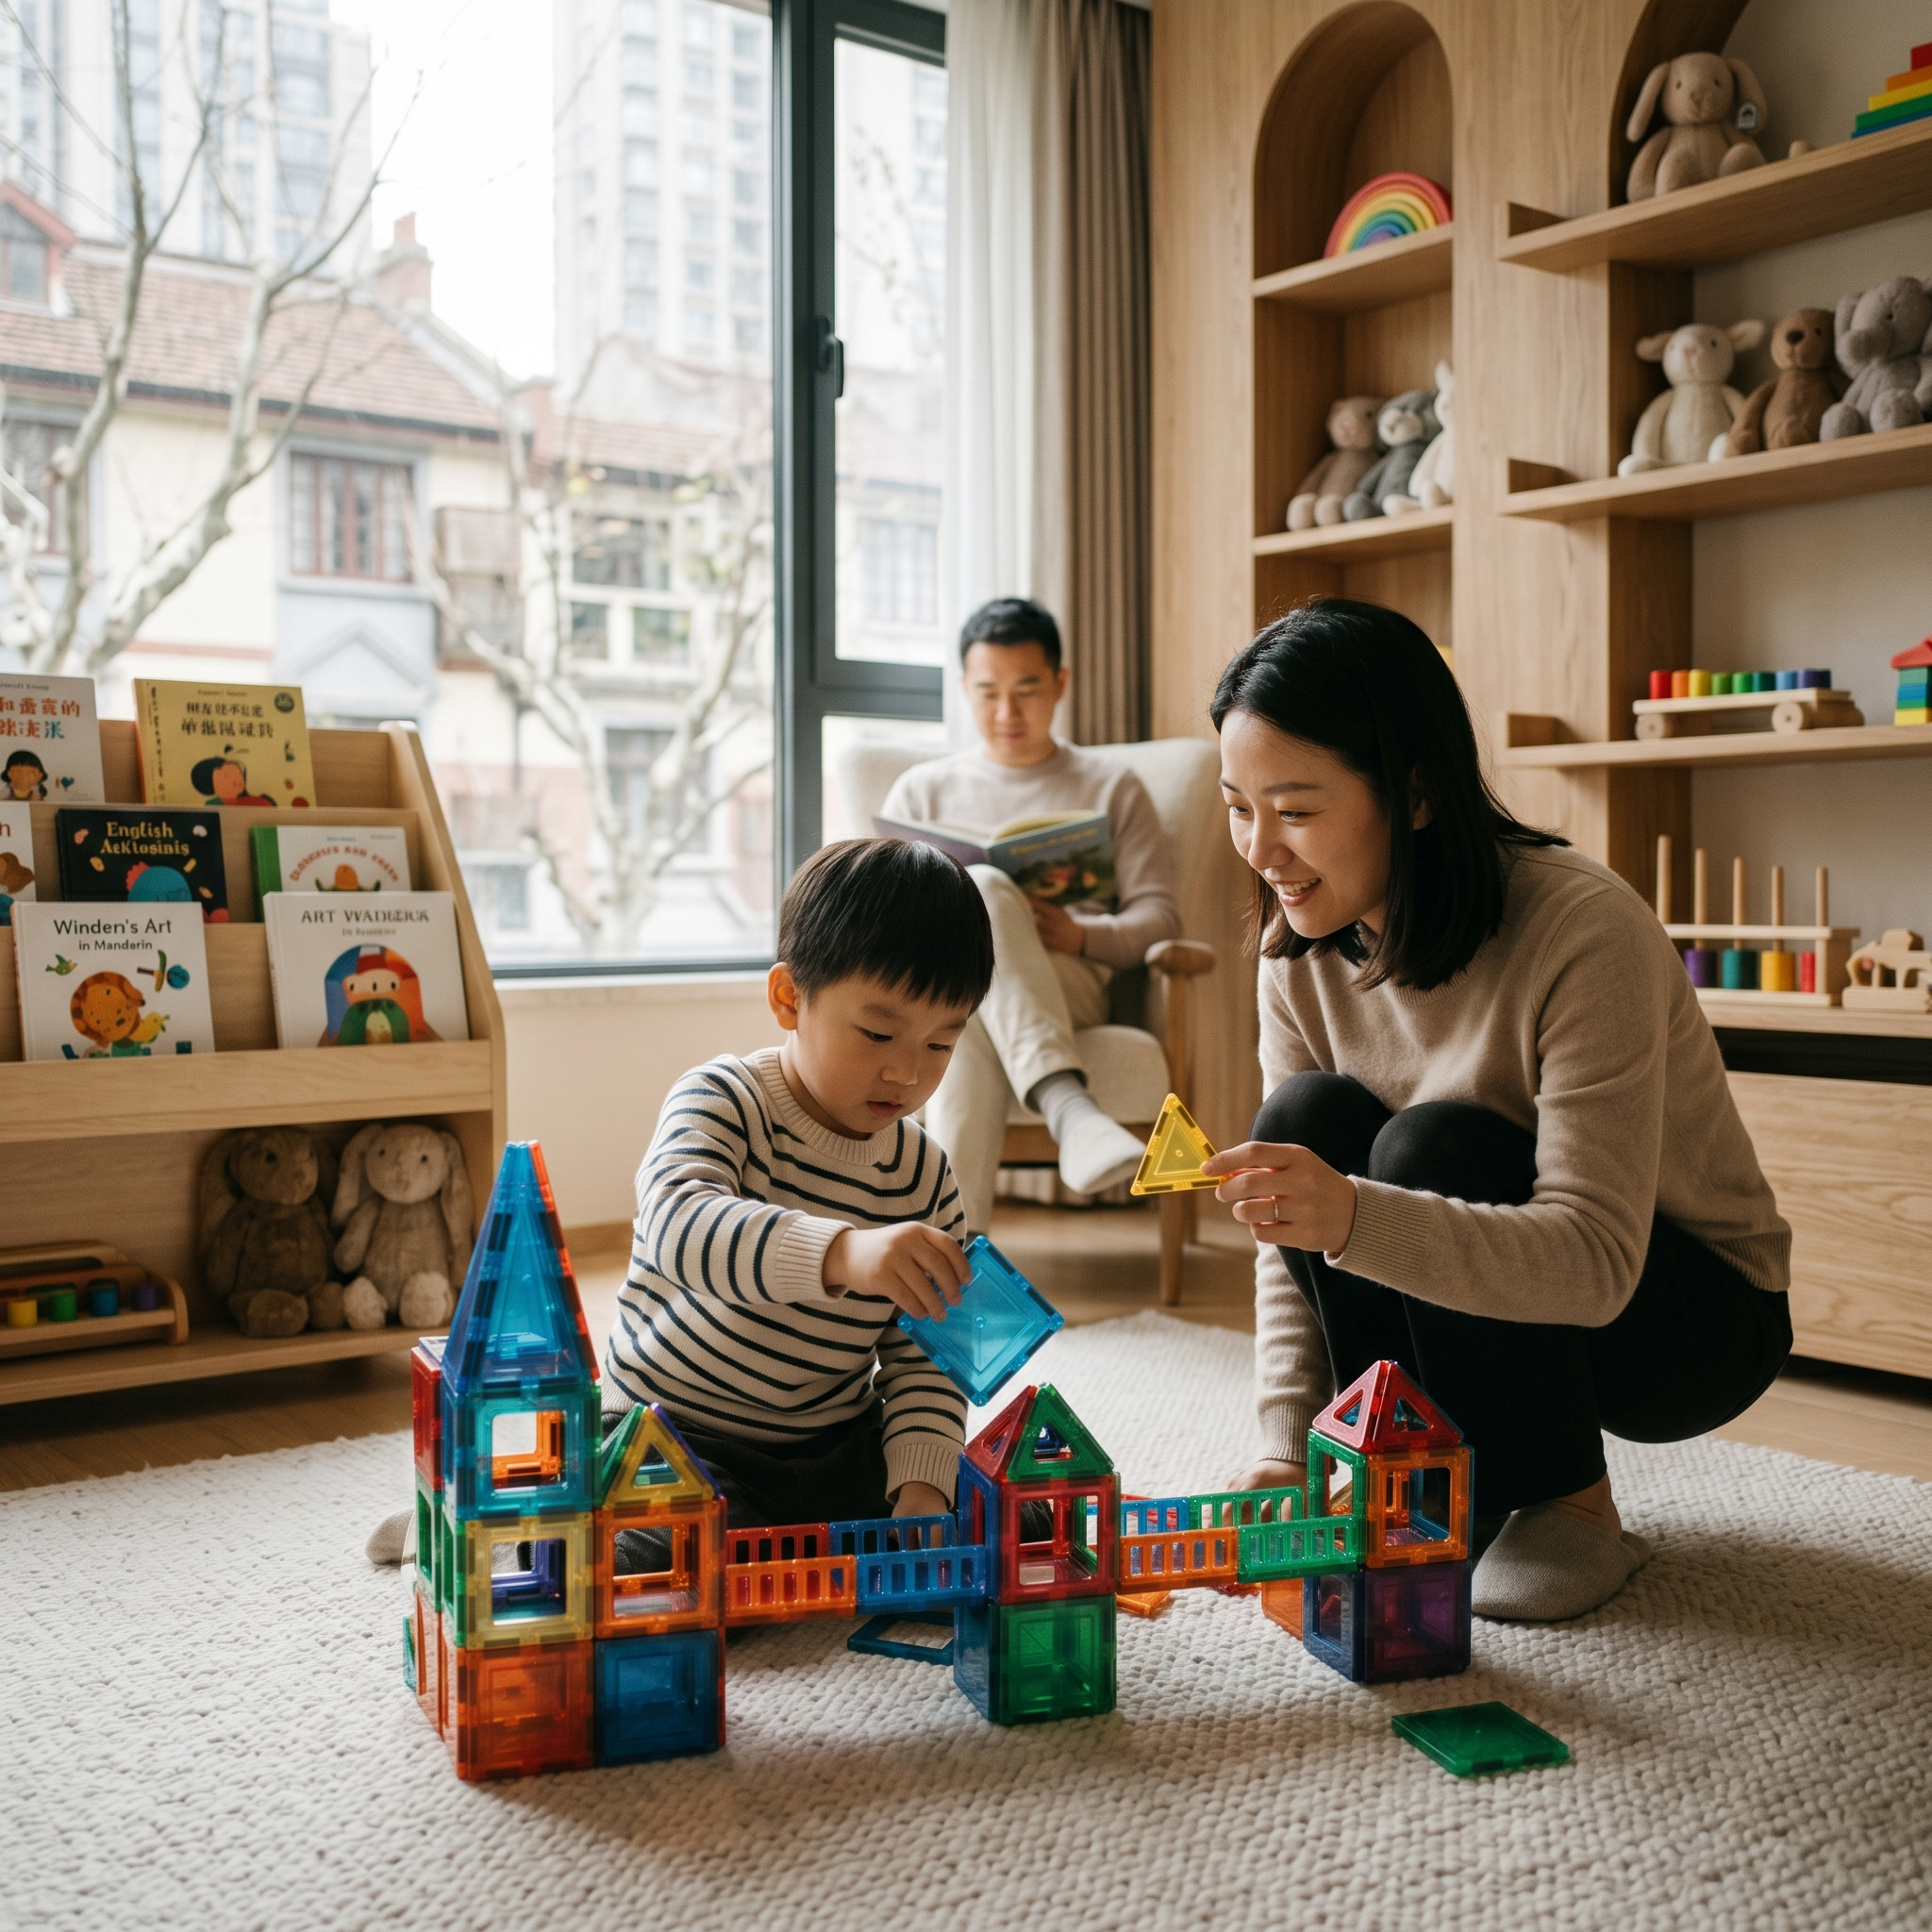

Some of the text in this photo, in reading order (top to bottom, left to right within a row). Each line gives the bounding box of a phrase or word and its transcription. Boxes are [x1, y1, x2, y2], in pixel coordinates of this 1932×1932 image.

[107, 821, 174, 840] English
[301, 909, 336, 924] ART
[54, 918, 172, 935] Winden's Art
[78, 941, 91, 951] in
